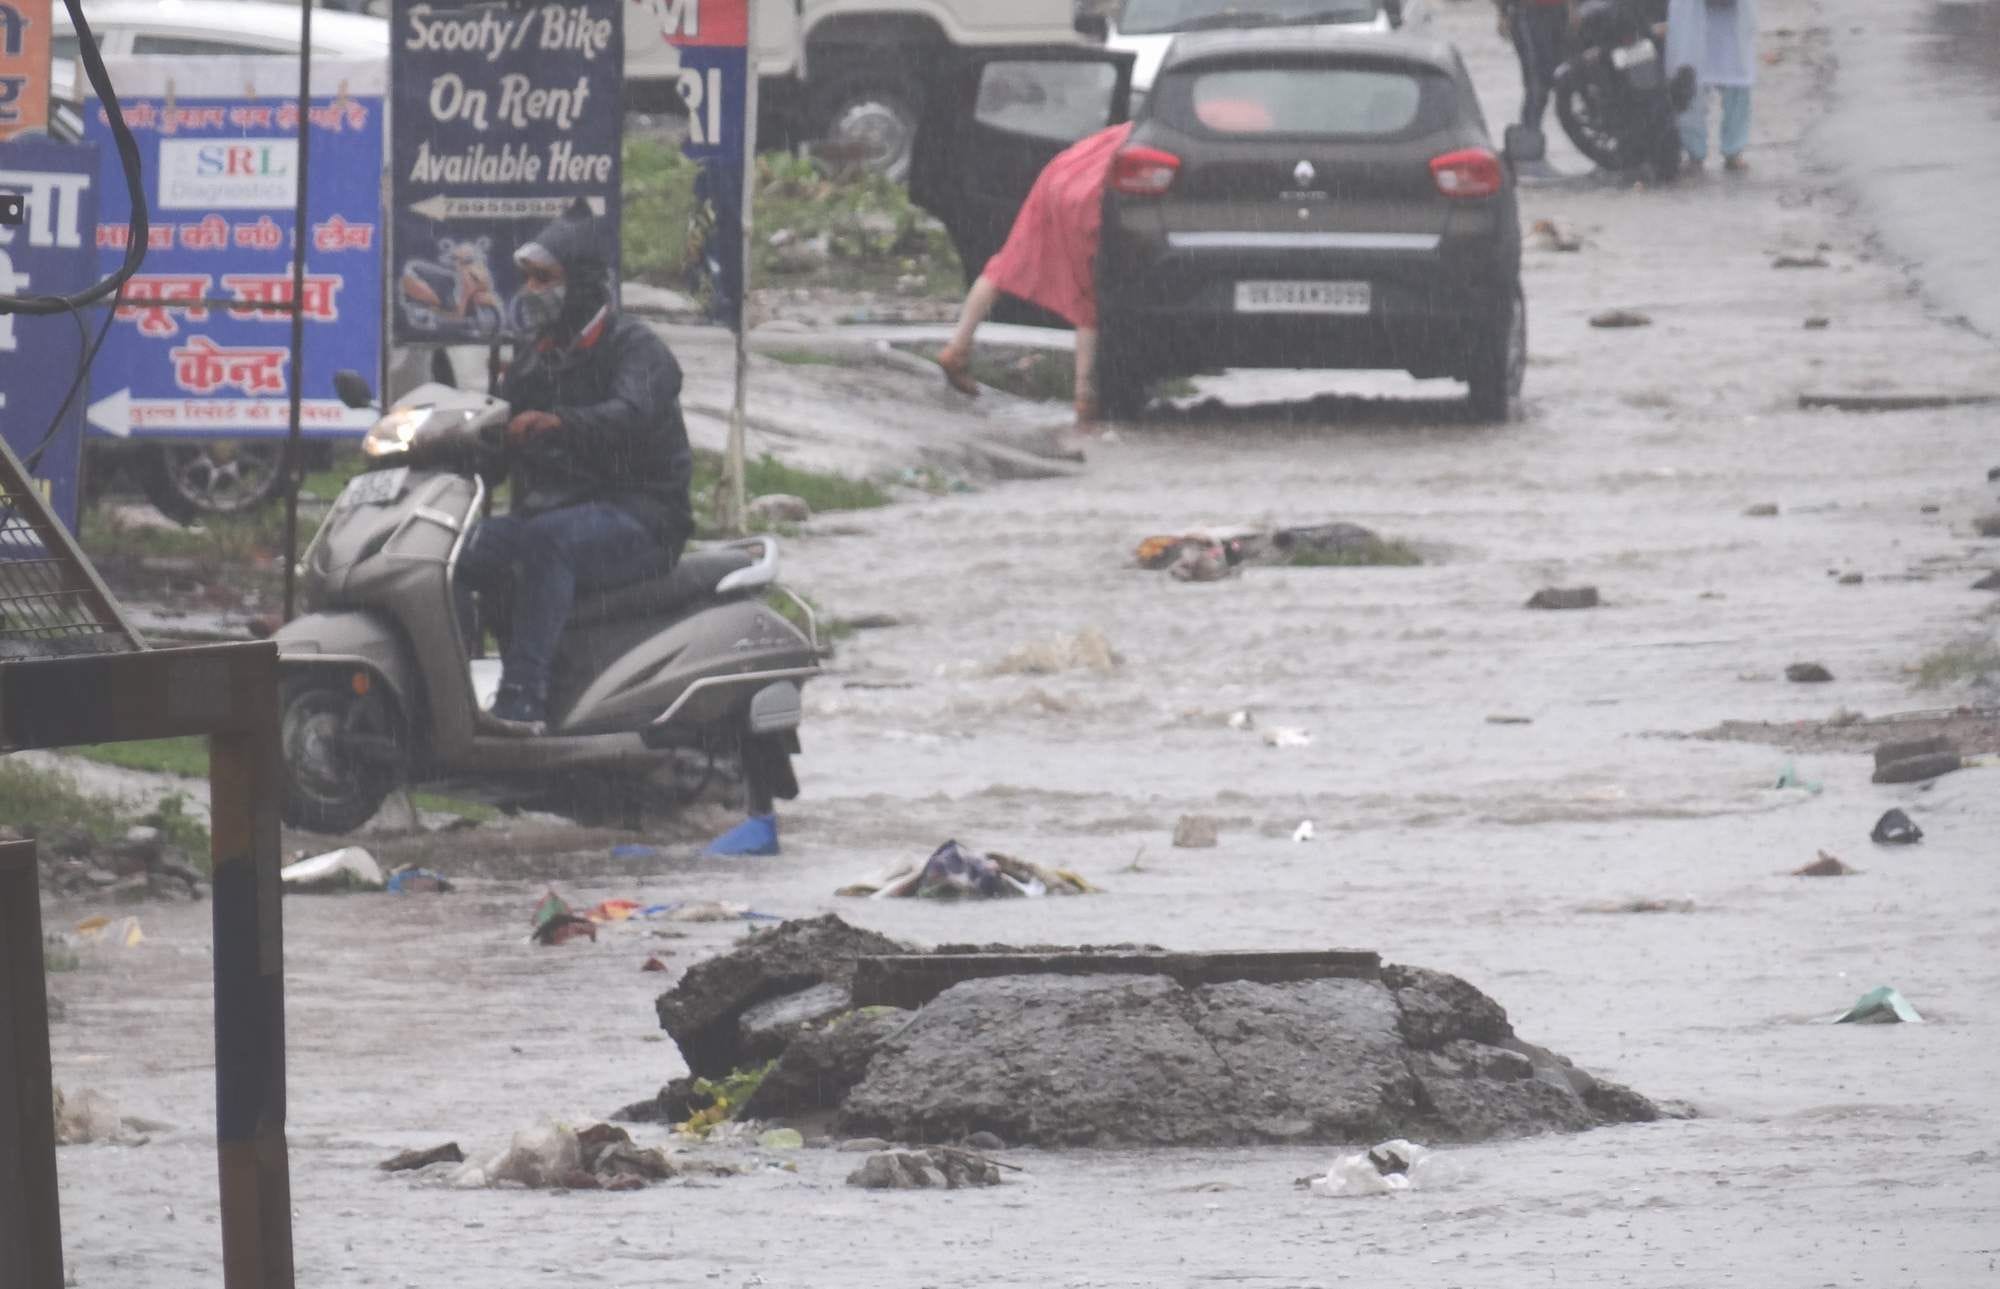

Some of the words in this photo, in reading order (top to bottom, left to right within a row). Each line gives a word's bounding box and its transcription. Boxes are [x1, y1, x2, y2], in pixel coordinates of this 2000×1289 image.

[540, 4, 612, 60] Bike
[430, 72, 488, 130] On
[498, 72, 590, 130] Rent
[197, 144, 287, 177] SRL
[409, 138, 541, 183] Available
[547, 140, 612, 183] Here
